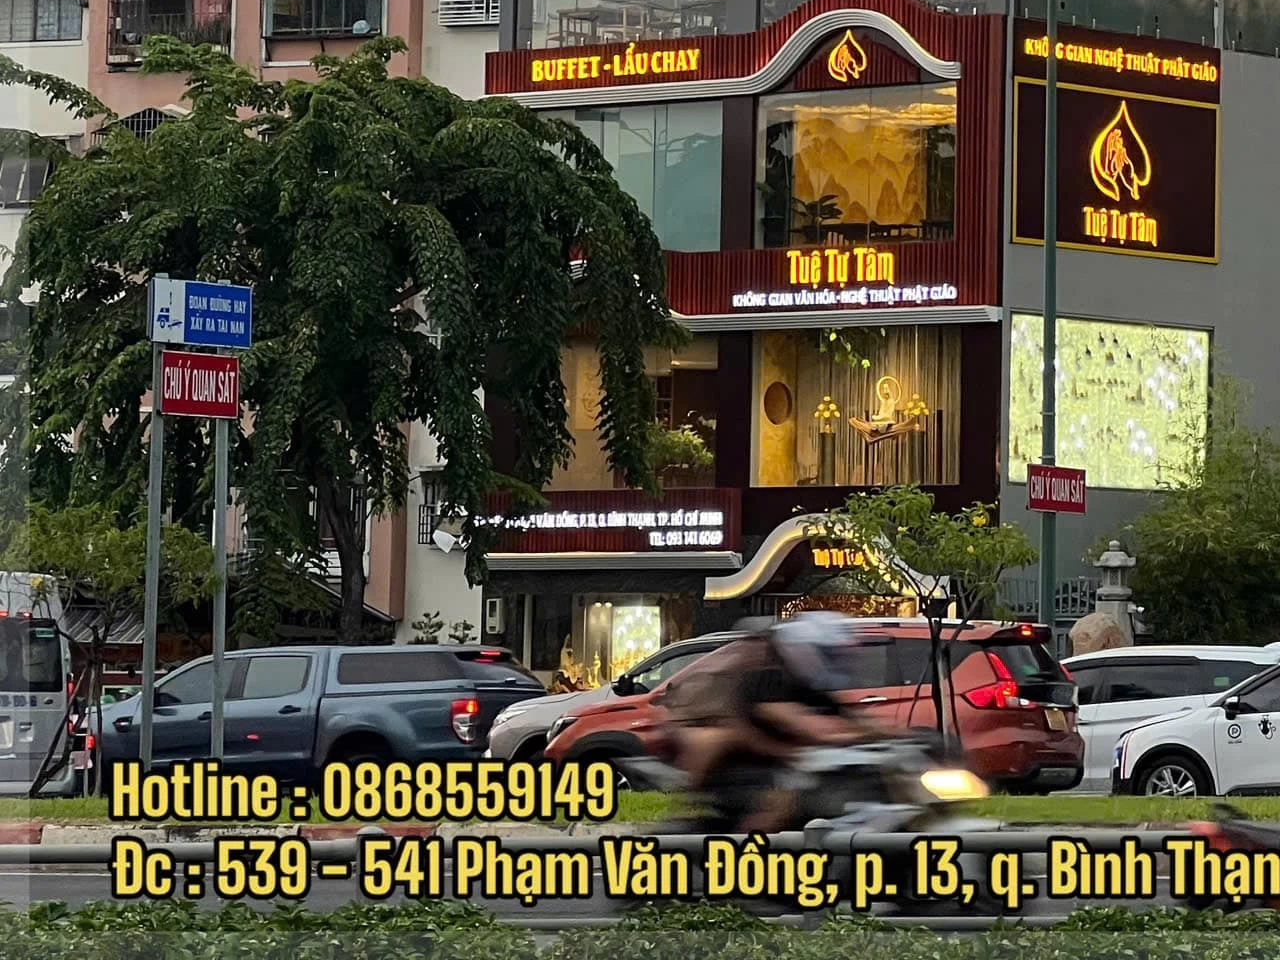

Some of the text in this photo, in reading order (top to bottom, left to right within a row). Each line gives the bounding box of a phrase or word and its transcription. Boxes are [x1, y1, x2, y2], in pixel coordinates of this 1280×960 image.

[532, 56, 600, 82] BUFFET
[613, 42, 649, 76] LẨU
[651, 48, 700, 74] CHAY
[1024, 36, 1064, 59] KHÔG
[1065, 44, 1093, 64] GIAN
[1095, 48, 1123, 73] NGHỆ
[1191, 60, 1218, 82] GIÁO
[1083, 206, 1158, 247] Tuệ Tự Tâm
[787, 247, 895, 289] Tuệ Tự Tâm
[233, 300, 247, 314] HAY
[732, 291, 766, 307] KHÔNG
[768, 293, 793, 307] GIAN
[795, 289, 815, 305] VĂN
[869, 286, 900, 305] THUẬT
[930, 283, 958, 301] GIÁO
[205, 318, 216, 332] RA
[217, 319, 228, 333] TAI
[164, 360, 236, 404] CHÚ Ý QUAN SÁT
[1031, 470, 1084, 504] CHÚ Ý QUAN SÁT
[666, 530, 683, 546] 093
[684, 531, 699, 546] 141
[699, 530, 724, 546] 6069
